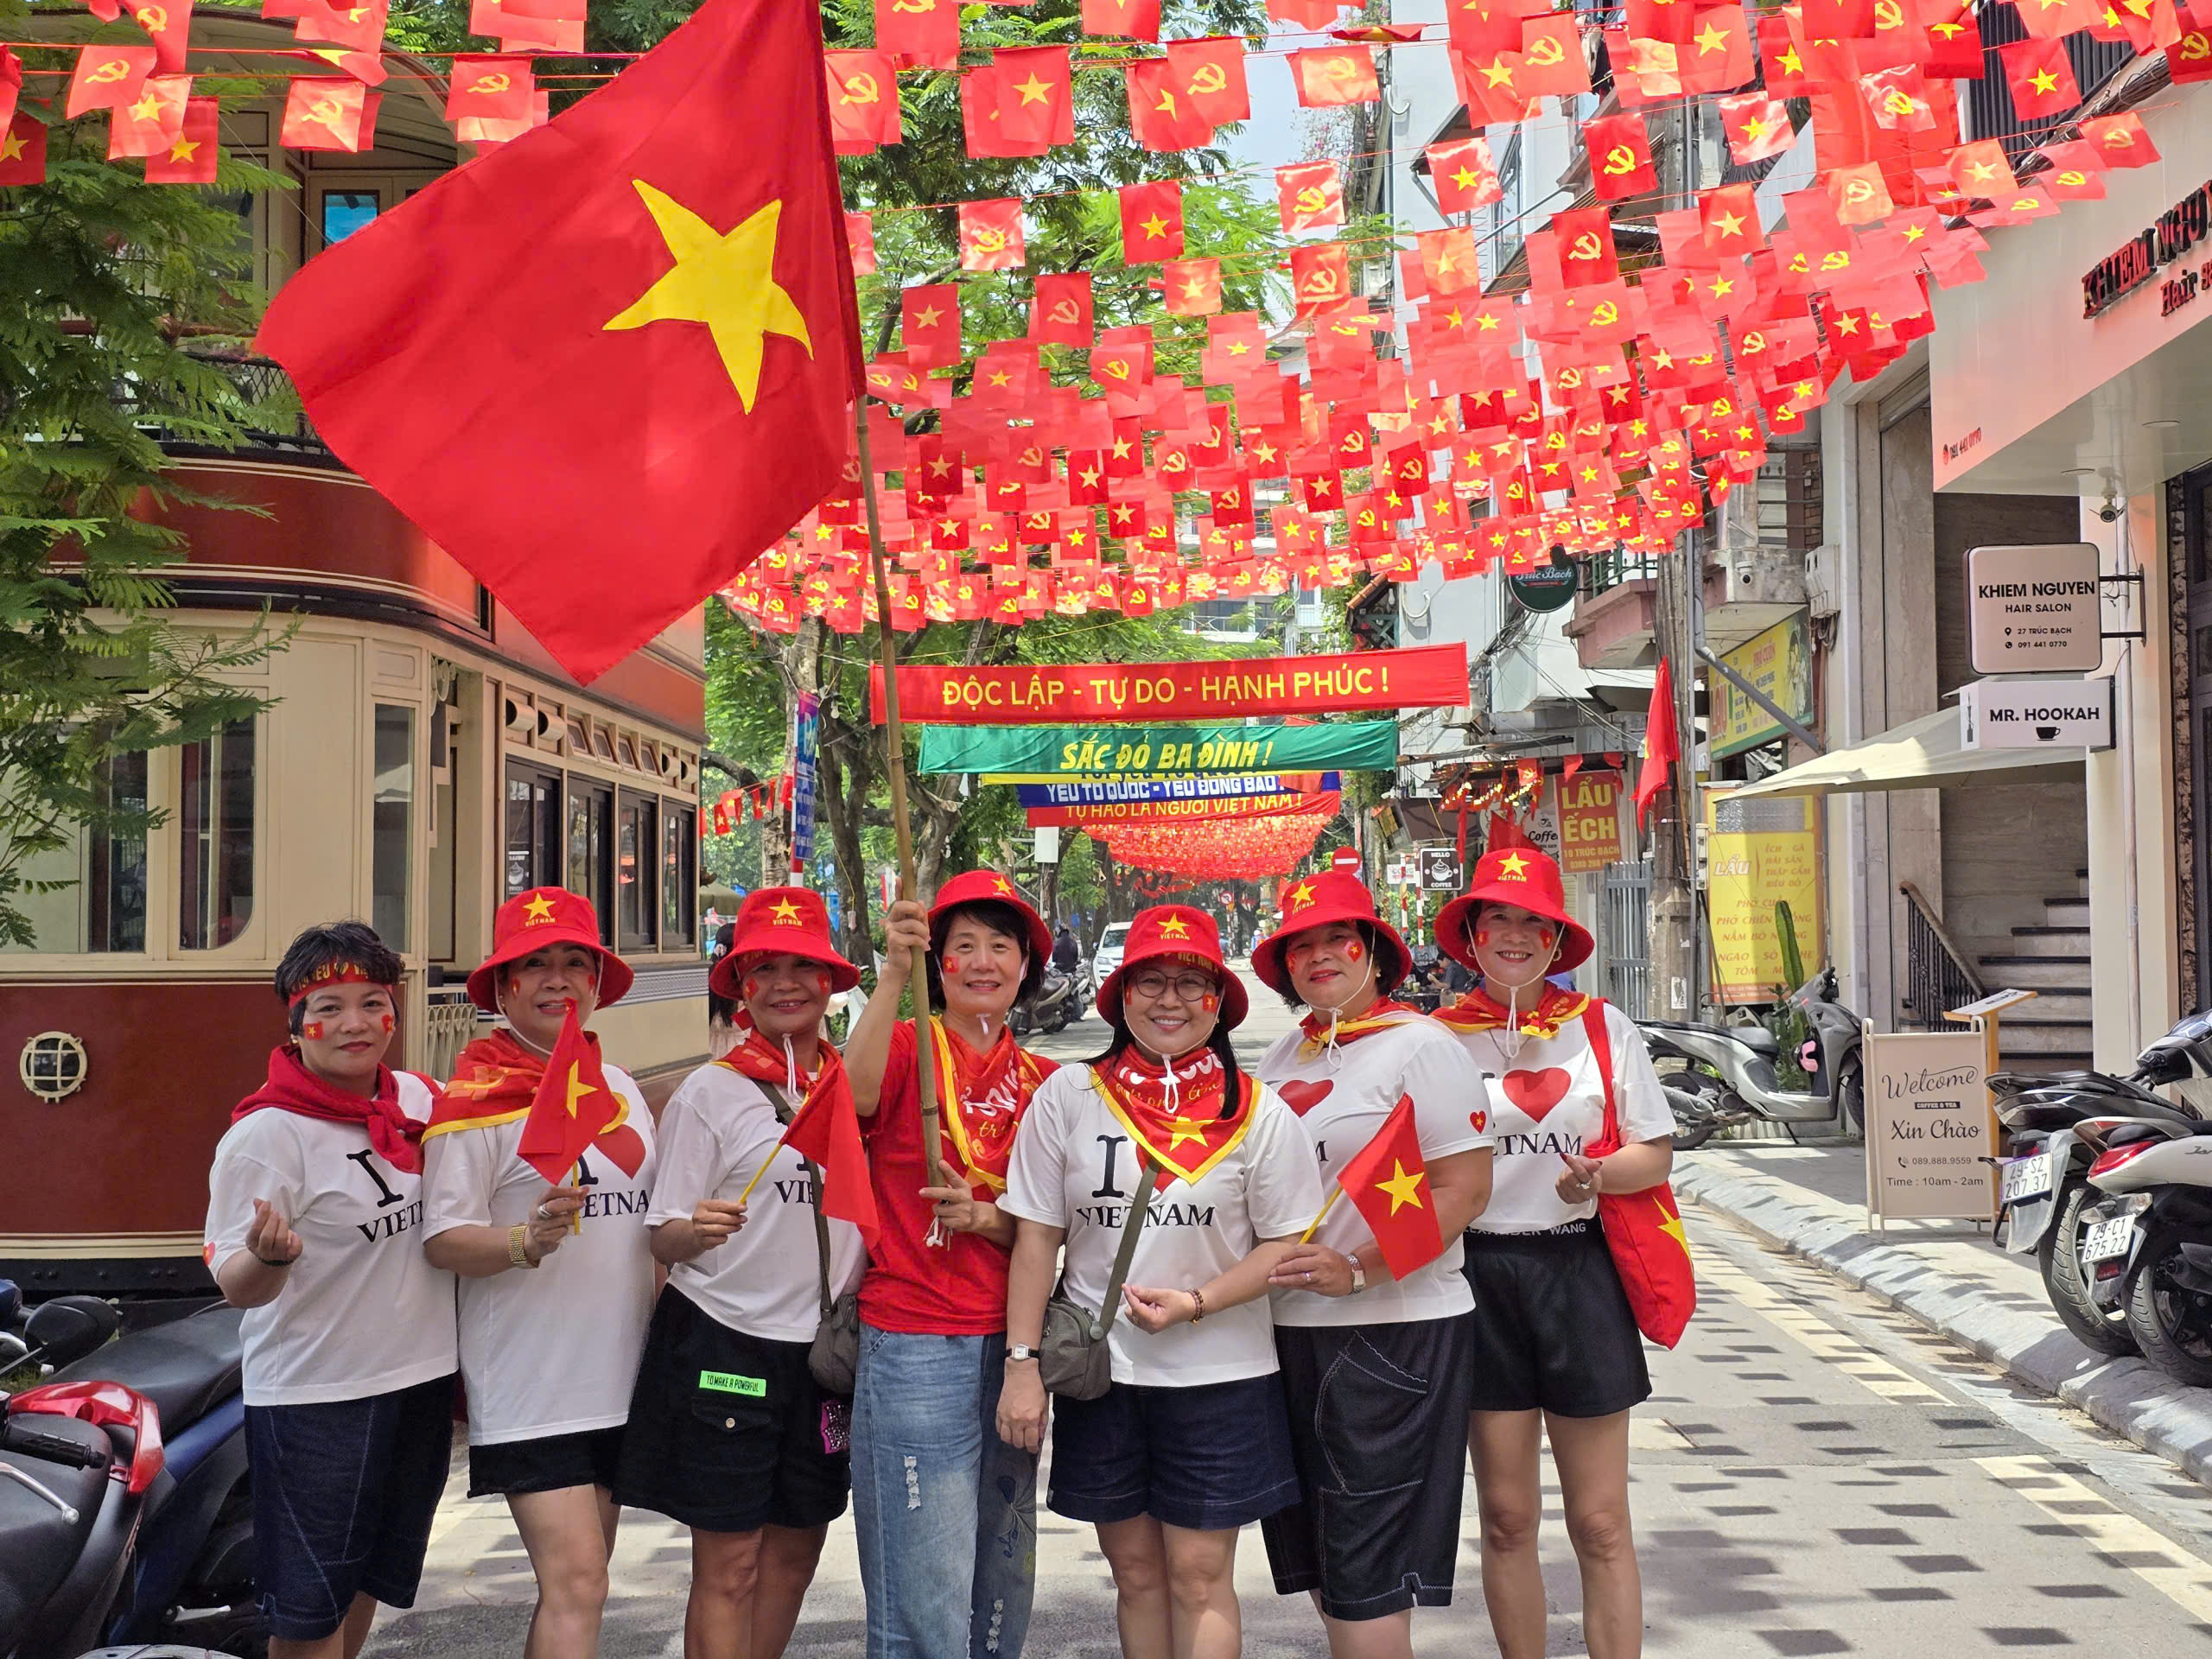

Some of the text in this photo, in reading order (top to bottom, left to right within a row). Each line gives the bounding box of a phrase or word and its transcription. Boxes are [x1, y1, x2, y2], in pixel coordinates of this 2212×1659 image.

[2082, 227, 2157, 319] KHIEM
[2161, 270, 2197, 316] Hair
[1979, 582, 2095, 598] KHIEM NGUYEN
[2005, 603, 2071, 613] HAIR SALON
[2050, 627, 2072, 636] BẠCH
[943, 674, 1002, 711] ĐỘC
[1011, 674, 1065, 711] LẬP
[1090, 677, 1128, 710] TỰ
[1135, 677, 1174, 703] DO
[1202, 673, 1285, 706] HẠNH
[1294, 664, 1373, 697] PHÚC
[1382, 667, 1389, 692] !
[1990, 708, 2100, 721] MR. HOOKAH
[1060, 733, 1273, 770] SẮC ĐỎ BA ĐÌNH !
[1255, 793, 1293, 810] NAM
[1297, 793, 1302, 806] !
[1561, 776, 1611, 809] LẨU
[1529, 830, 1558, 842] Coffe
[1563, 812, 1616, 842] ẾCH
[1713, 854, 1750, 876] LẨU
[1882, 1065, 1979, 1099] Welcome
[1891, 1119, 1981, 1140] Xin Chào
[1493, 1133, 1582, 1156] TNAM
[346, 1148, 404, 1208] I
[1091, 1135, 1128, 1198] I
[2010, 1156, 2044, 1179] 29-S2
[1887, 1177, 1913, 1186] Time
[1923, 1177, 1951, 1185] 10am
[1961, 1177, 1983, 1185] 2am
[2005, 1173, 2048, 1199] 207.37
[580, 1188, 654, 1218] ETNA
[1076, 1203, 1215, 1229] VIENAM
[1549, 1223, 1586, 1236] WANG
[2093, 1219, 2126, 1241] 29-C1
[2085, 1236, 2126, 1260] 675.22
[734, 1379, 759, 1392] POWERFUL
